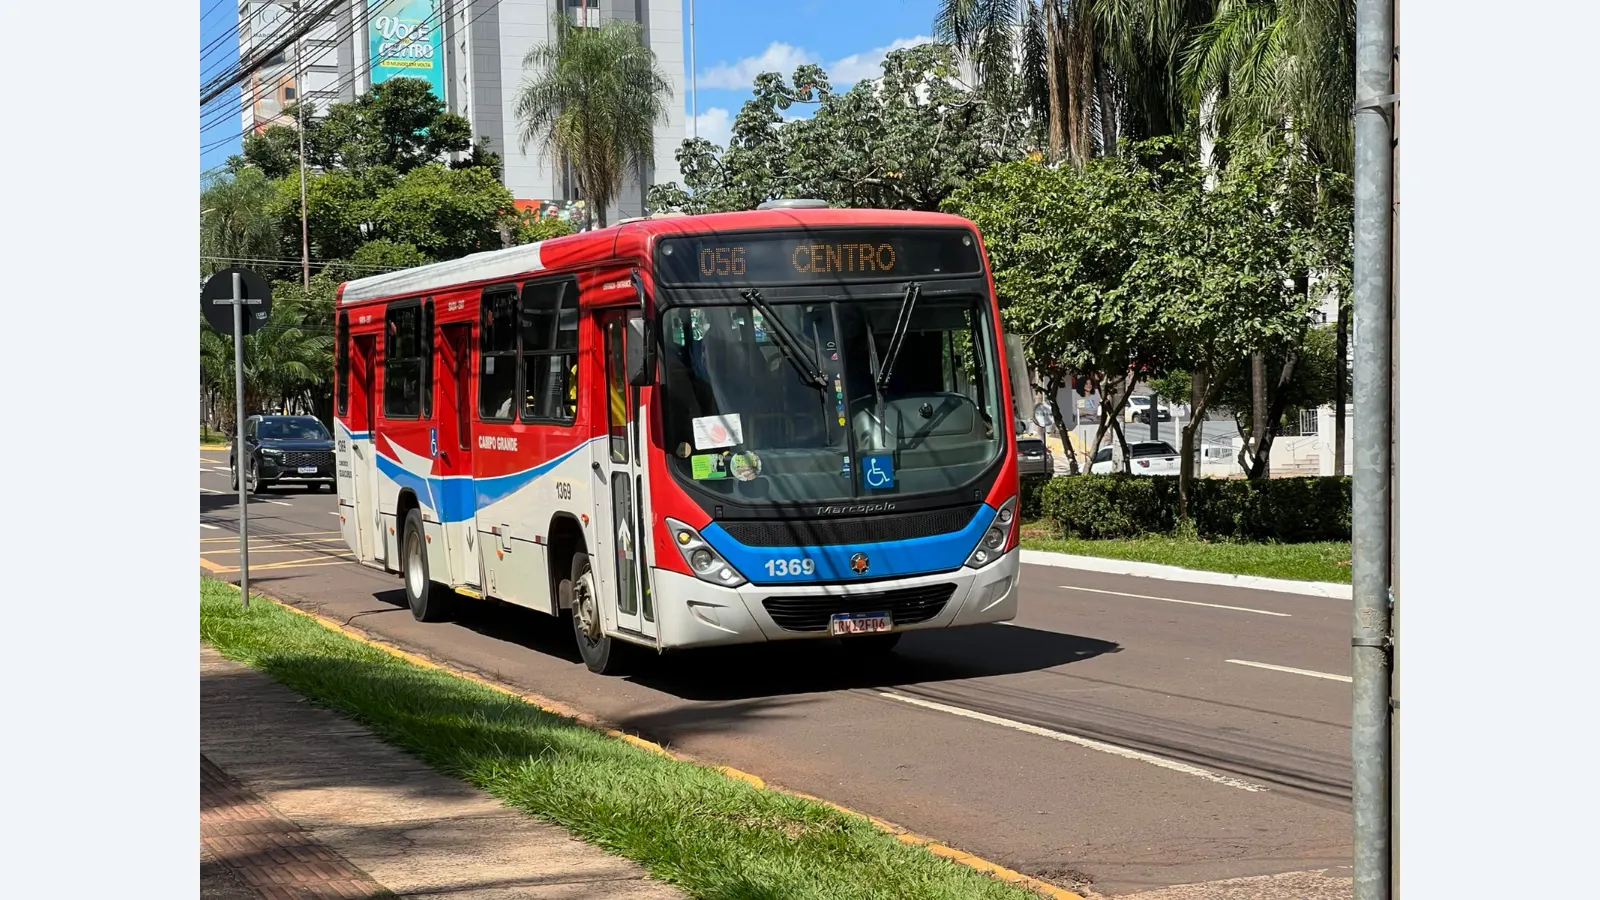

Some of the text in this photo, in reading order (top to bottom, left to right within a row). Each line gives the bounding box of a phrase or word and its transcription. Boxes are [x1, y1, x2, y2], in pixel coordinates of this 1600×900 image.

[700, 243, 896, 276] 056 CENTRO
[479, 435, 518, 452] CAMPO GRANDE
[556, 481, 571, 500] 1369
[817, 502, 896, 515] Marcopolo
[764, 558, 815, 577] 1369
